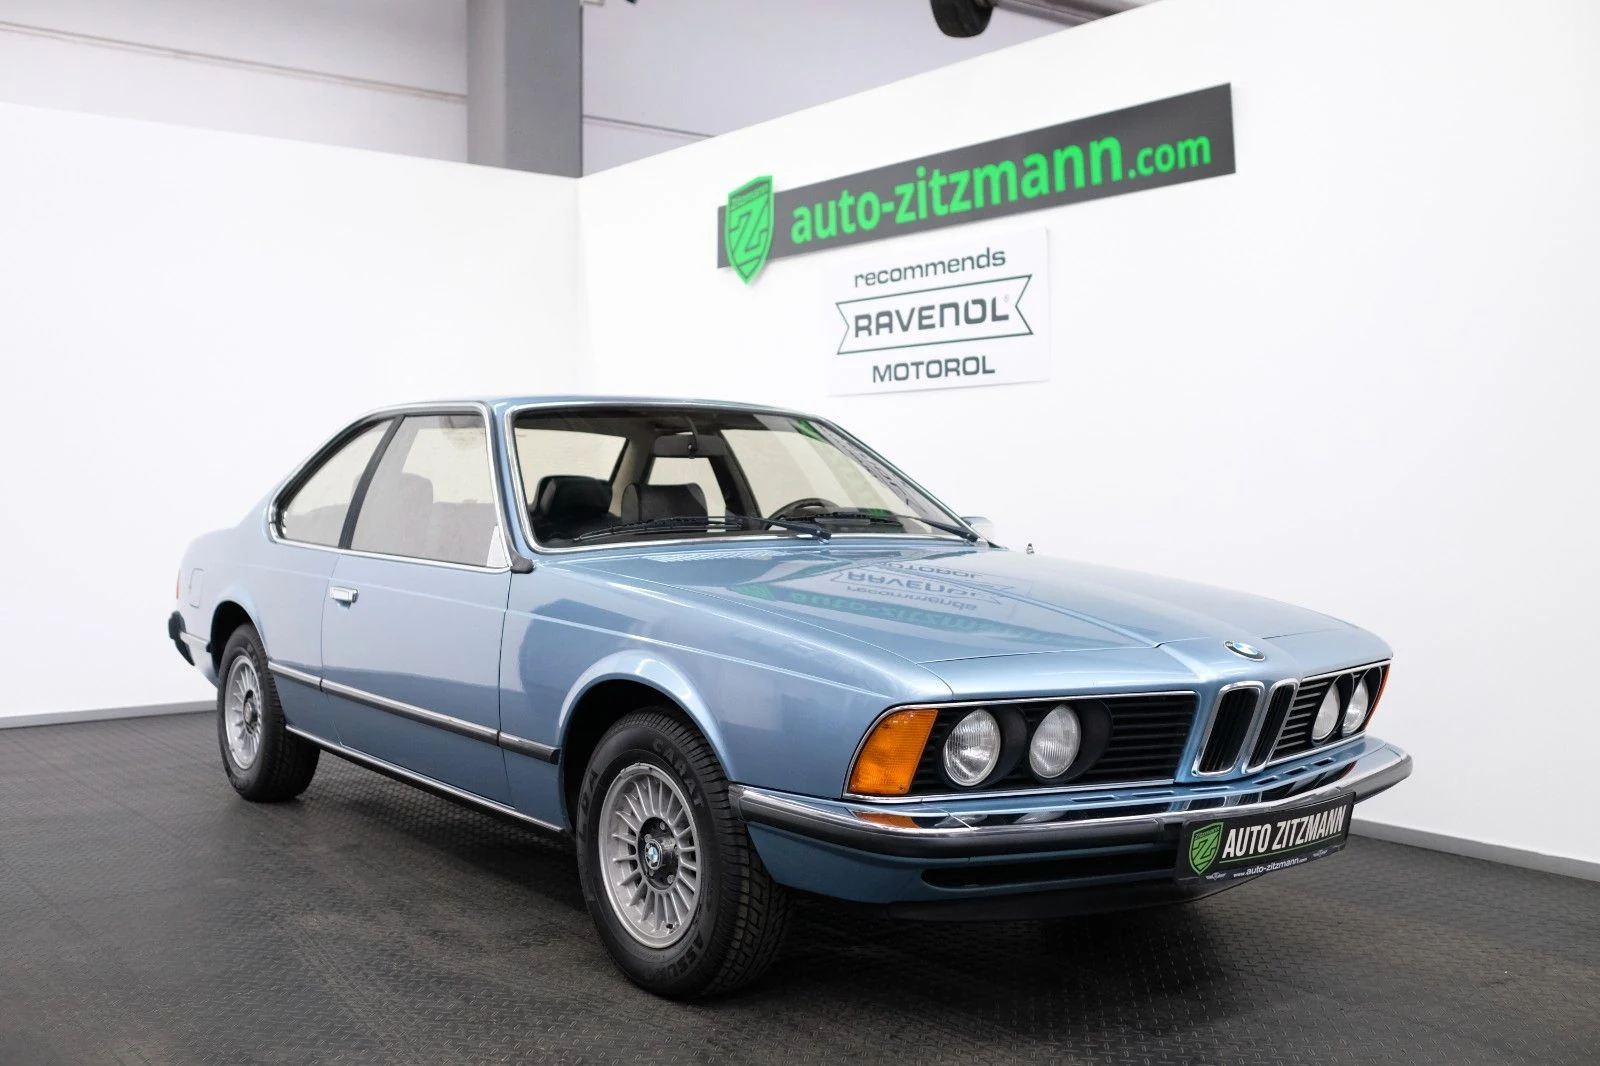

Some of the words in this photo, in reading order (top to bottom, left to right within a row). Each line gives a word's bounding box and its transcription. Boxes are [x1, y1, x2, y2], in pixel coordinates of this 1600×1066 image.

[791, 136, 1212, 244] auto-zitzmann.com
[854, 247, 1006, 288] recommends
[854, 297, 1009, 338] RAVENOL
[872, 355, 996, 383] MOTOROL
[1221, 823, 1272, 859] AUTO
[1271, 804, 1347, 851] ZITZMANN
[1233, 857, 1308, 878] www.auto-zitzmann.com
